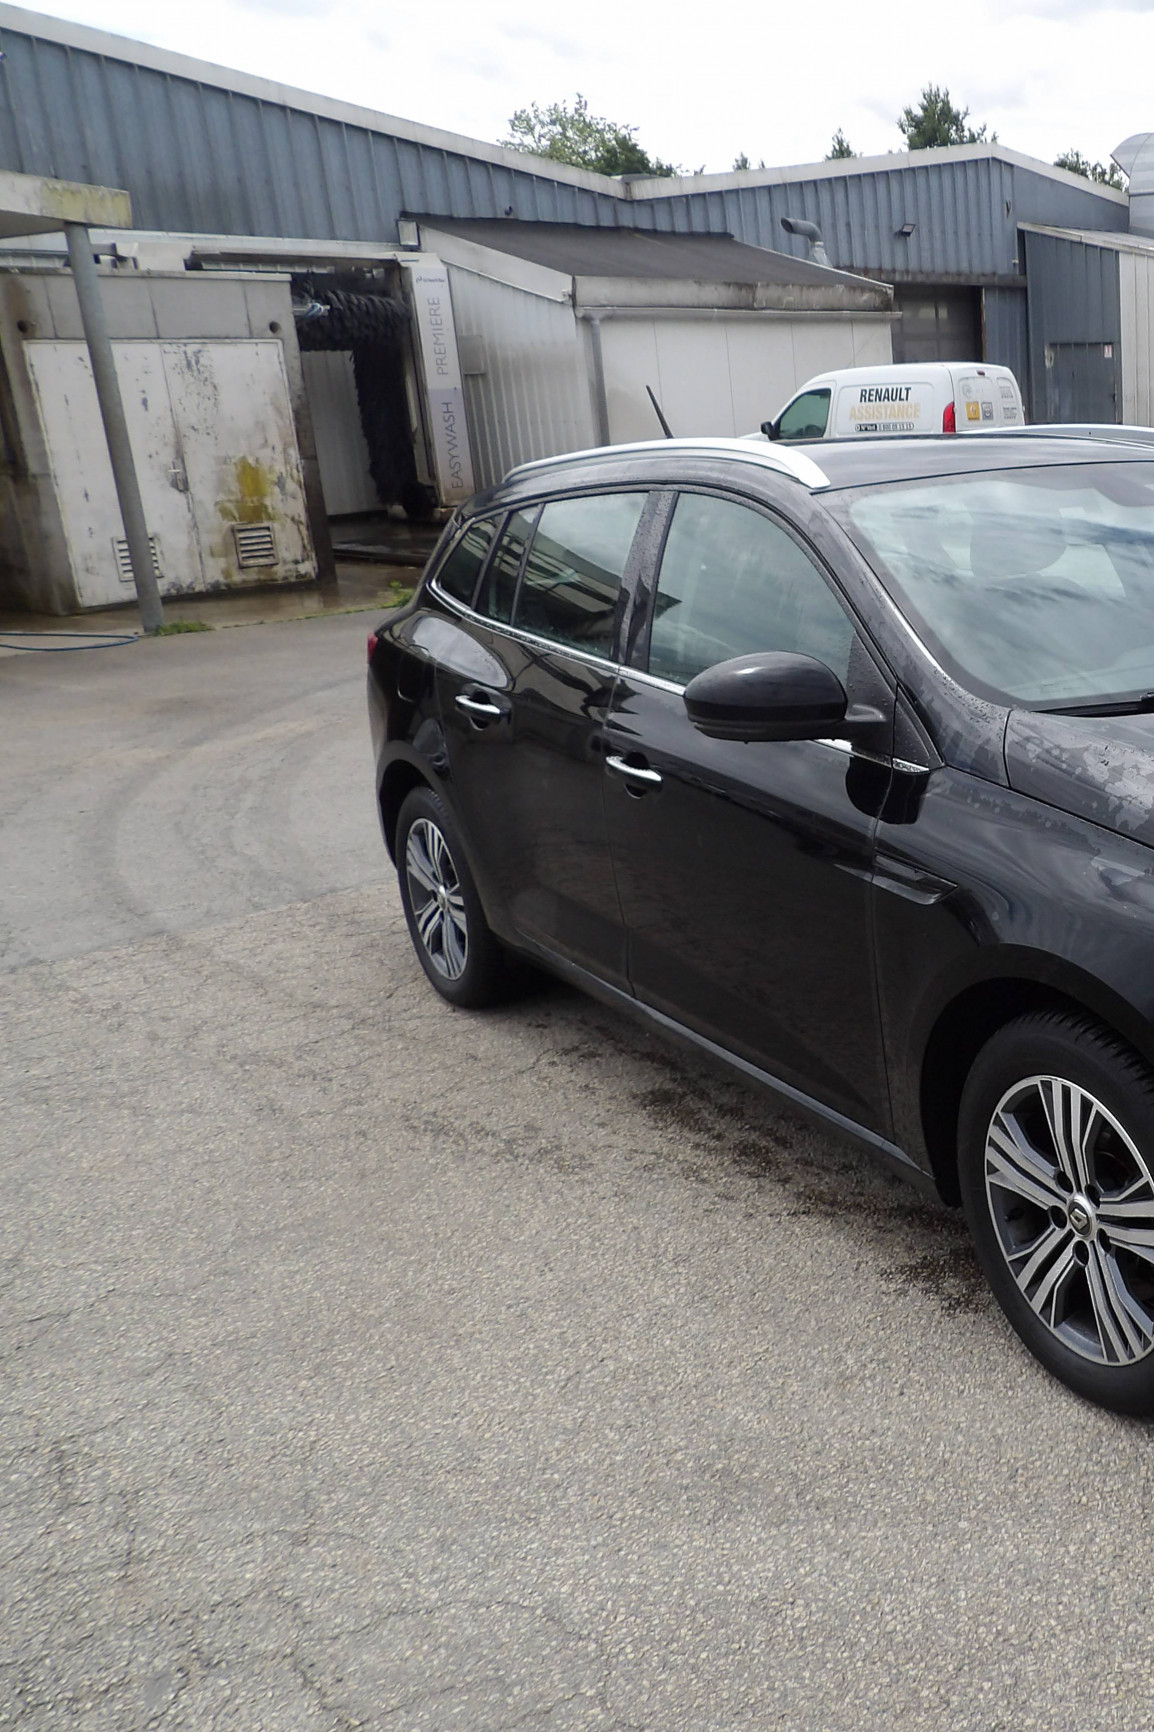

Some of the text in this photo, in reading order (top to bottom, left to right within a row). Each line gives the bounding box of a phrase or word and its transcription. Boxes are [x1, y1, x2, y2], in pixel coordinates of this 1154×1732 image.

[859, 387, 912, 403] RENAULT
[849, 403, 920, 421] ASSISTANCE
[441, 402, 464, 489] EASYWASH
